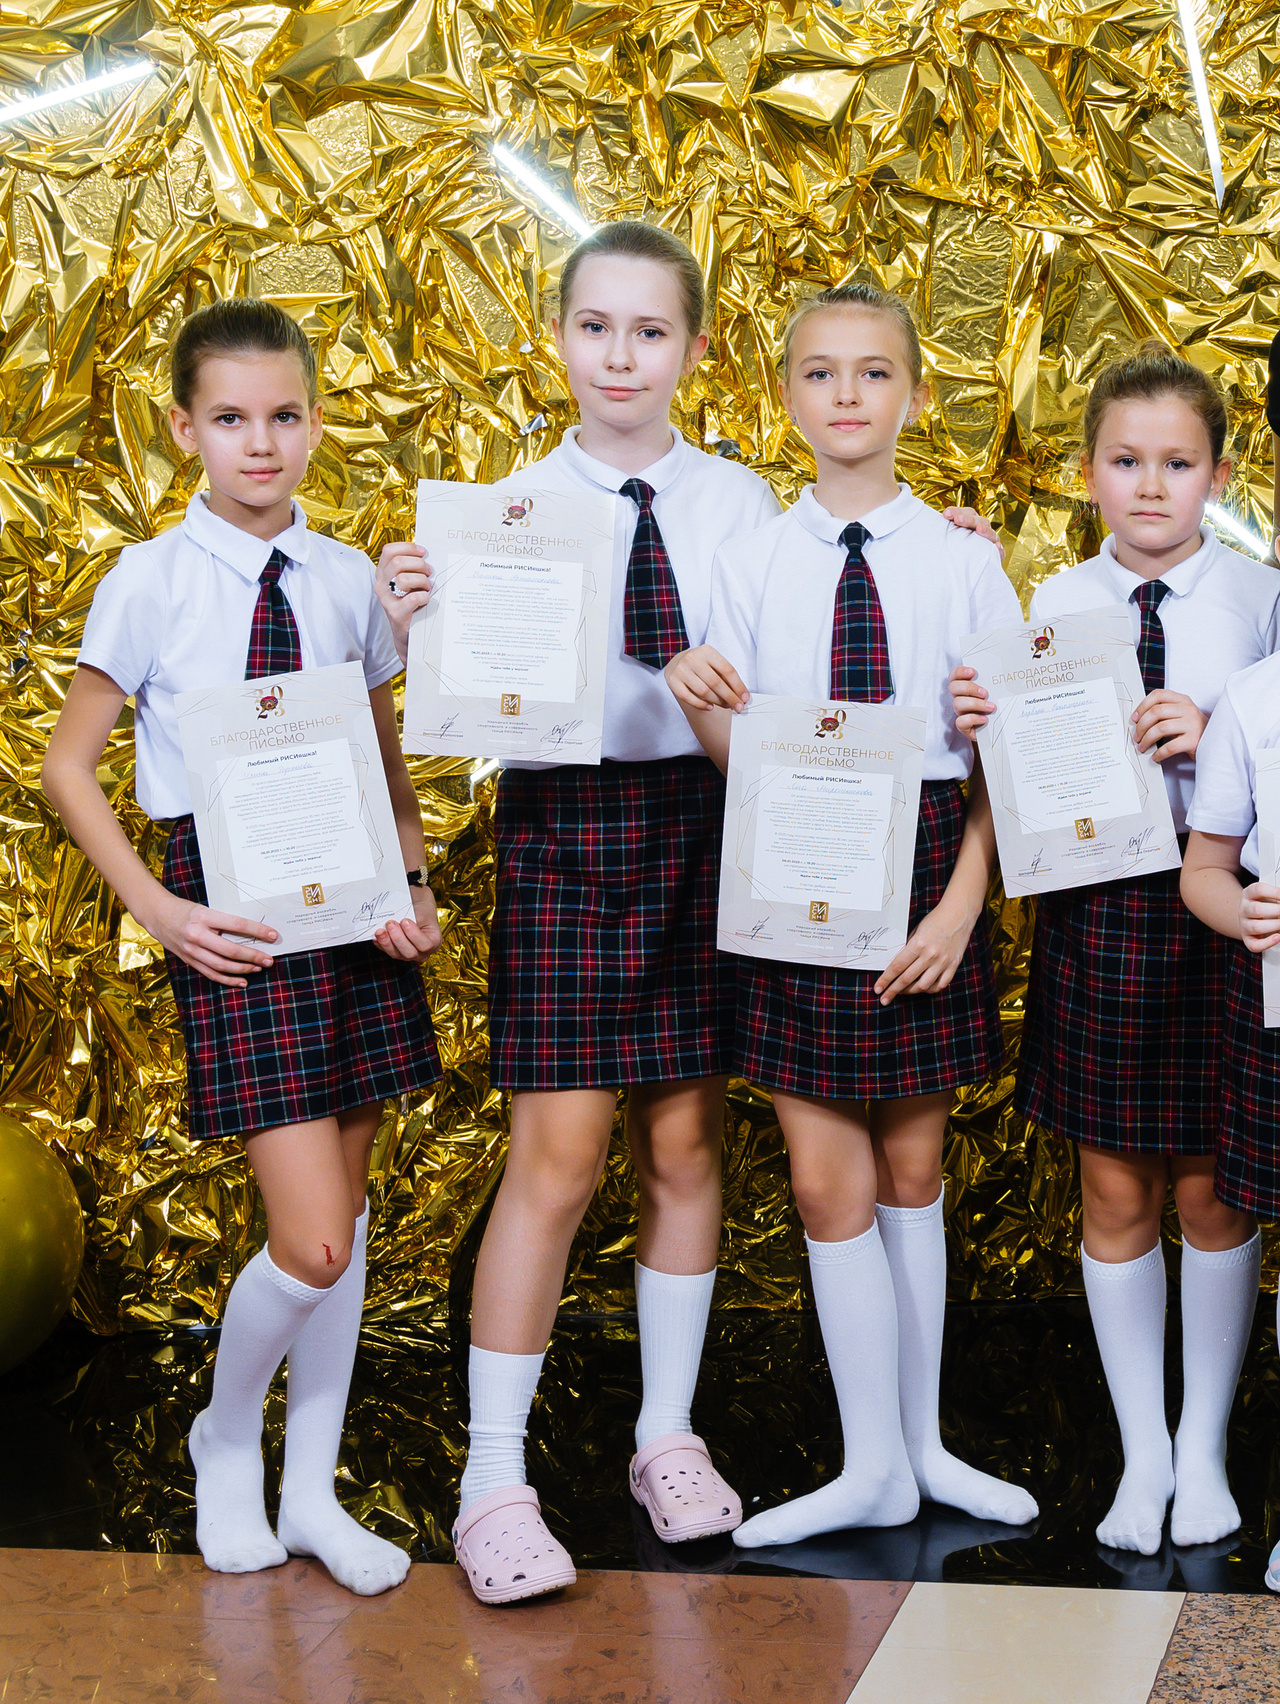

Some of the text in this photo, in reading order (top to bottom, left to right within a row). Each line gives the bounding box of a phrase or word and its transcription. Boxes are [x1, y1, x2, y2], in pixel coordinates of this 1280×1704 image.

[447, 530, 583, 549] БЛАГОДАРСТВЕННОЕ
[487, 543, 543, 556] ПИСЬМО
[480, 562, 513, 570] Любимый
[992, 654, 1107, 684] БЛАГОДАРСТВЕННОЕ
[1026, 672, 1074, 689] ПИСЬМО
[1025, 695, 1052, 705] Любимый
[1053, 689, 1085, 700] РИСИяшка!
[210, 714, 343, 747] БЛАГОДАРСТВЕННОЕ
[248, 733, 305, 751] ПИСЬМО
[761, 741, 894, 760] БЛАГОДАРСТВЕННОЕ
[247, 750, 318, 767] Любимый РИСИяшка!
[799, 755, 855, 768] ПИСЬМО
[826, 776, 862, 784] РИСИяшка!
